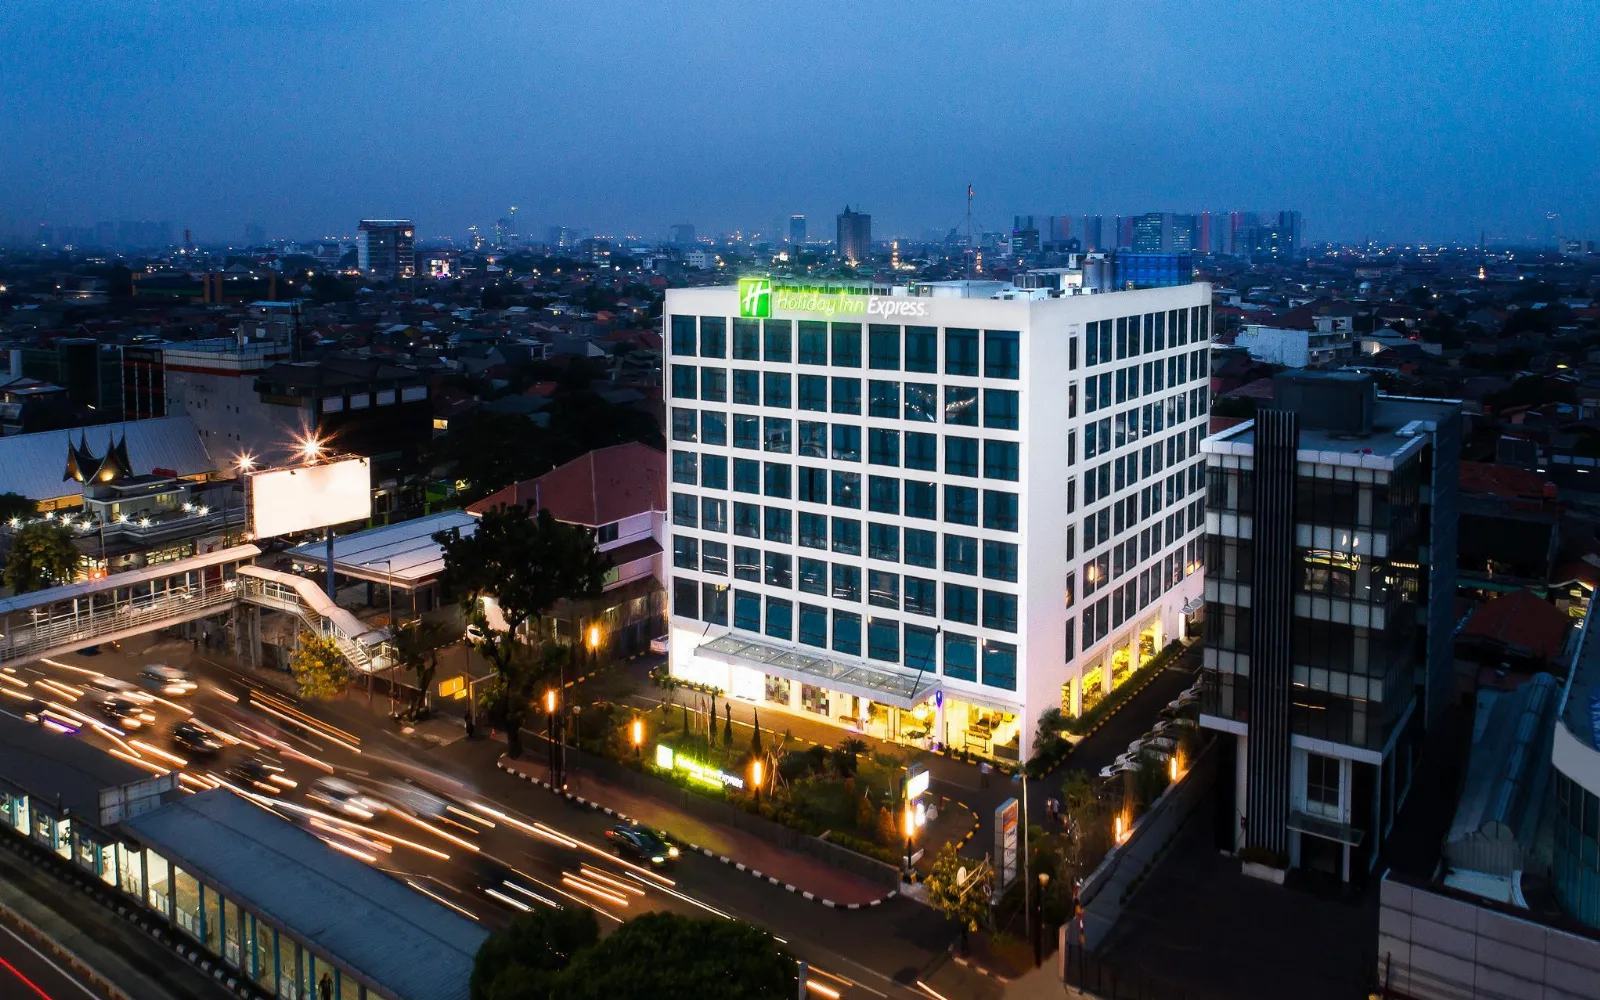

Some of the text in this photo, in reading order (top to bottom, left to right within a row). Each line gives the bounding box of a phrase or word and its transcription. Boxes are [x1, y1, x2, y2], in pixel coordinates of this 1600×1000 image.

[776, 289, 925, 319] Holiday Inn Express
